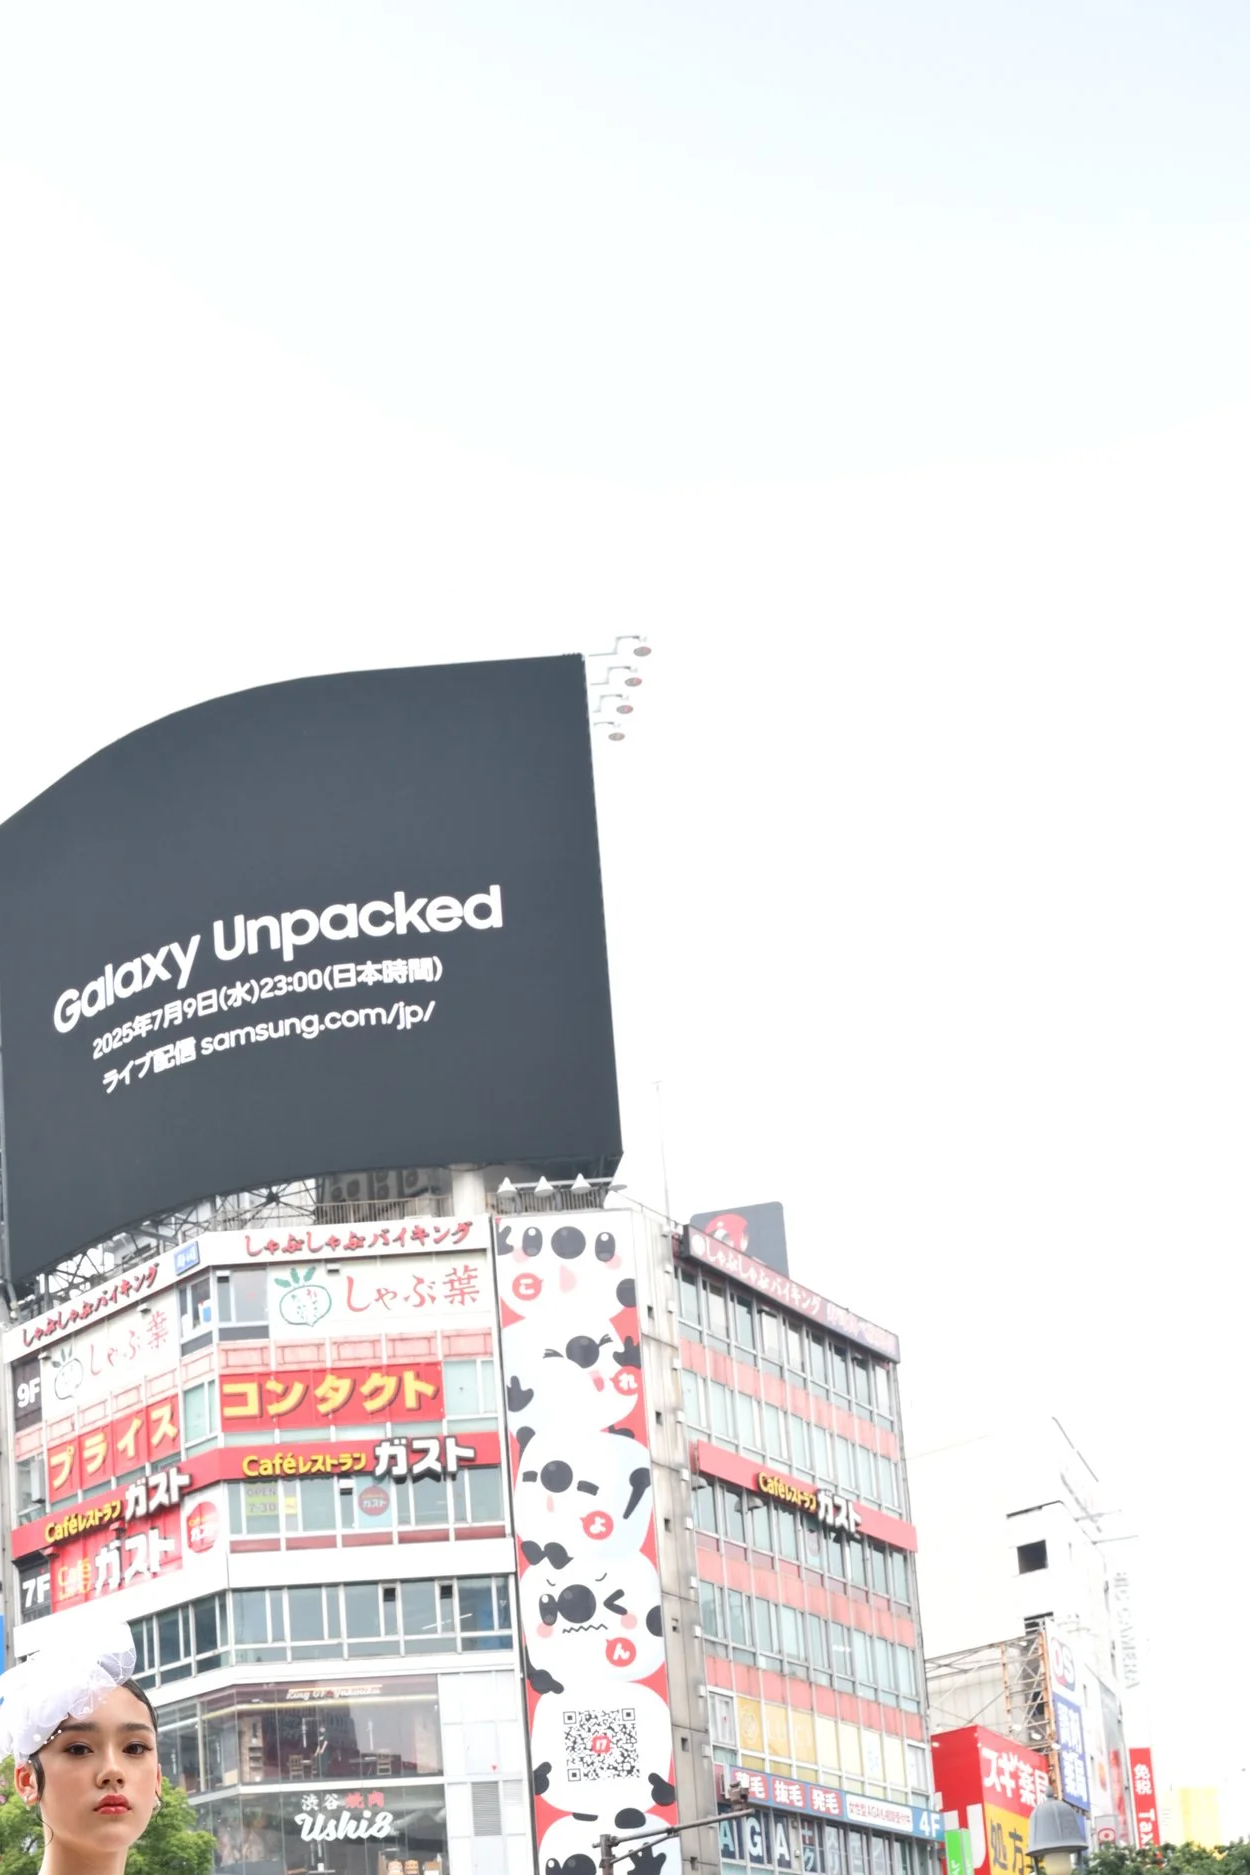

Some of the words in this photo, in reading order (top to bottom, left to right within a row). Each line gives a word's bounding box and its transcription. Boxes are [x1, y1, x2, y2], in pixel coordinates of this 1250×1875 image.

[53, 935, 201, 1033] Galaxy
[213, 885, 503, 961] Unpacked
[92, 956, 443, 1059] 2025年7月9日(水)23:00(日本時間)
[103, 1037, 196, 1093] ライブ配信
[201, 1001, 436, 1057] samsung.com/jp/
[245, 1221, 473, 1256] しゃぶしゃぶバイキング
[346, 1264, 480, 1312] しゃぶ葉
[518, 1278, 535, 1294] こ
[706, 1237, 822, 1315] しゃぶしゃぶバイキング
[23, 1262, 159, 1347] しゃぶしゃぶバイキング
[90, 1311, 169, 1375] しゃぶ葉
[17, 1378, 40, 1408] 9F
[223, 1370, 438, 1417] コンタクト
[50, 1403, 178, 1489] プライス
[374, 1437, 476, 1478] ガスト
[125, 1467, 191, 1521] ガスト
[95, 1529, 175, 1599] ガスト
[22, 1573, 50, 1607] 7F
[294, 1810, 393, 1842] Ushi8
[812, 1789, 840, 1815] 発毛
[918, 1811, 940, 1838] 4F
[720, 1817, 790, 1861] AGA
